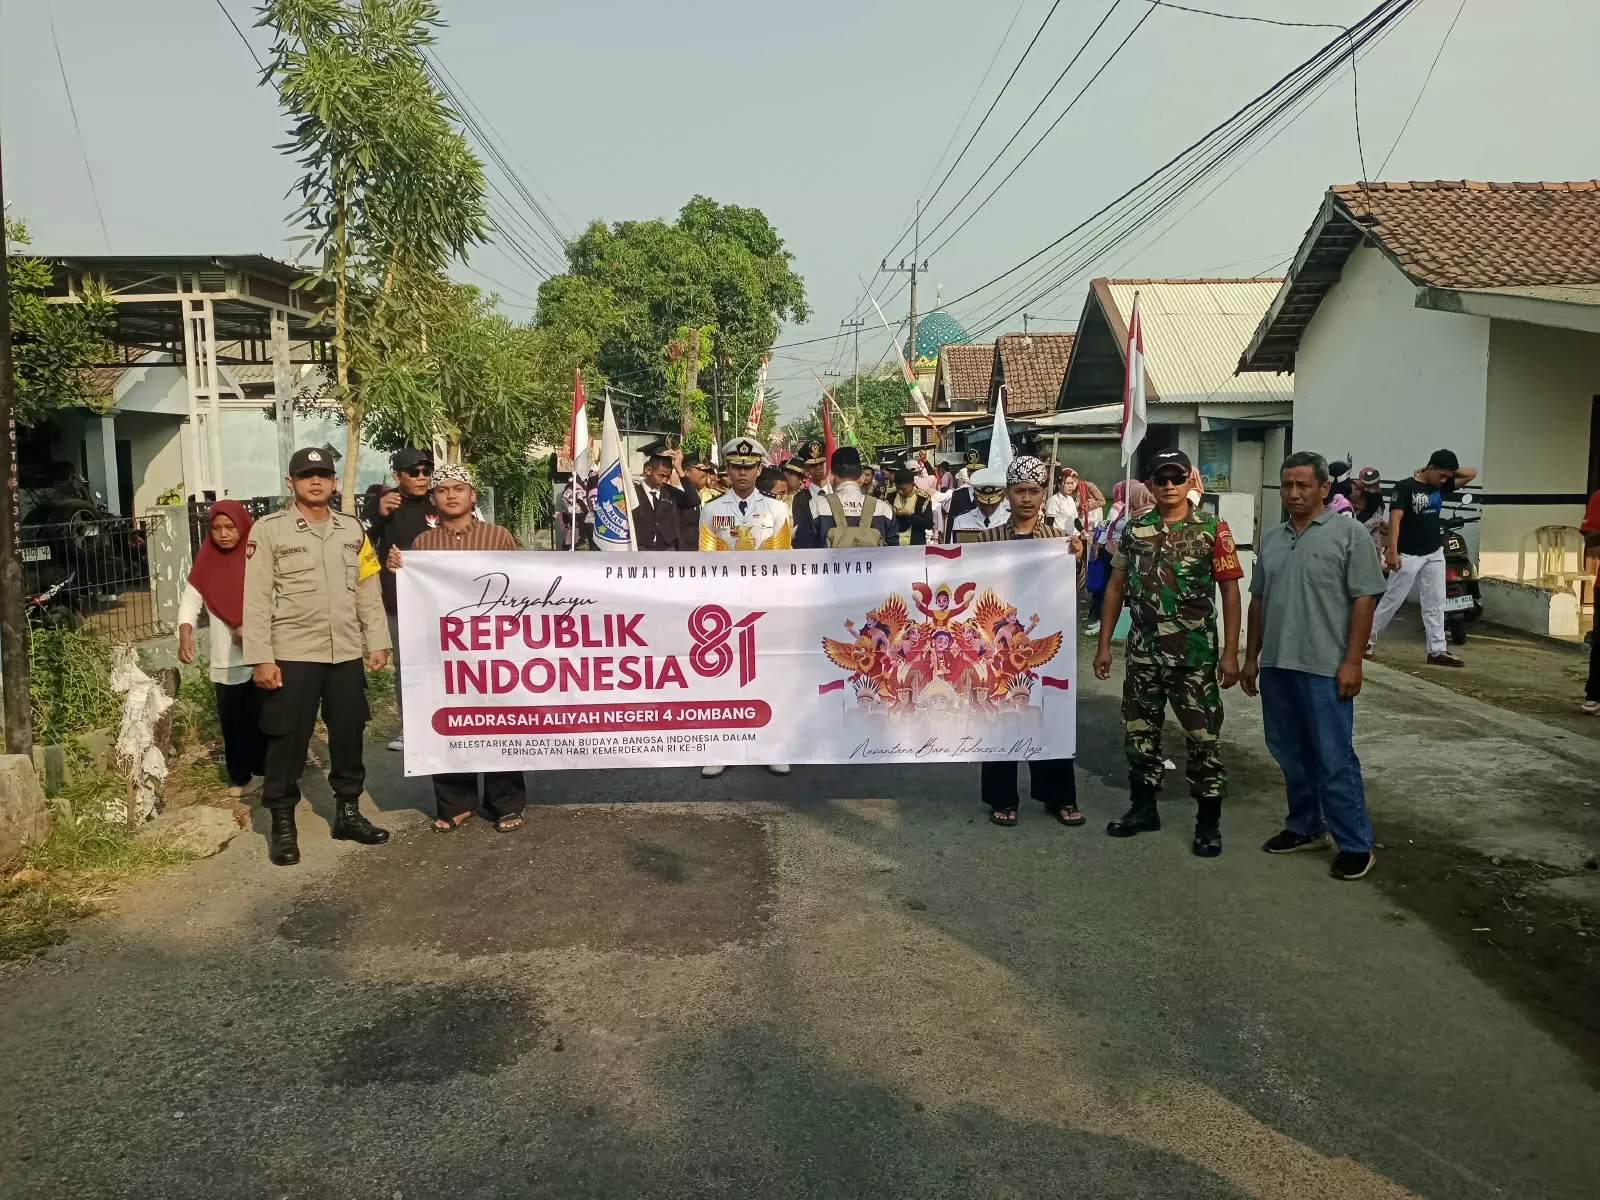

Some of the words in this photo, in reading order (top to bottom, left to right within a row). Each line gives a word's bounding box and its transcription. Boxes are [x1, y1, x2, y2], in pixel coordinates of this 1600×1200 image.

[607, 510, 623, 526] MAN
[605, 566, 657, 579] PAWAI
[668, 565, 729, 578] BUDAYA
[740, 564, 779, 577] DESA
[791, 561, 873, 577] DENANYAR
[446, 572, 598, 625] Dirgahayu
[440, 613, 649, 652] REPUBLIK
[687, 604, 768, 689] 81
[443, 655, 689, 695] INDONESIA
[448, 713, 539, 728] MADRASAH
[543, 711, 600, 725] ALIYAH
[604, 709, 659, 723] NEGERI
[663, 709, 673, 722] 4
[676, 707, 756, 721] JOMBANG
[449, 739, 522, 749] MELESTARIKAN
[525, 739, 551, 748] ADAT
[554, 738, 575, 747] DAN
[578, 737, 619, 747] BUDAYA
[622, 736, 664, 745] BANGSA
[666, 734, 720, 743] INDONESIA
[722, 733, 756, 742] DALAM
[501, 747, 563, 756] PERINGATAN
[566, 747, 589, 756] HARI
[592, 745, 664, 755] KEMERDEKAAN
[667, 744, 676, 753] RI
[679, 743, 706, 752] KE-81
[949, 736, 1006, 758] Indonesia
